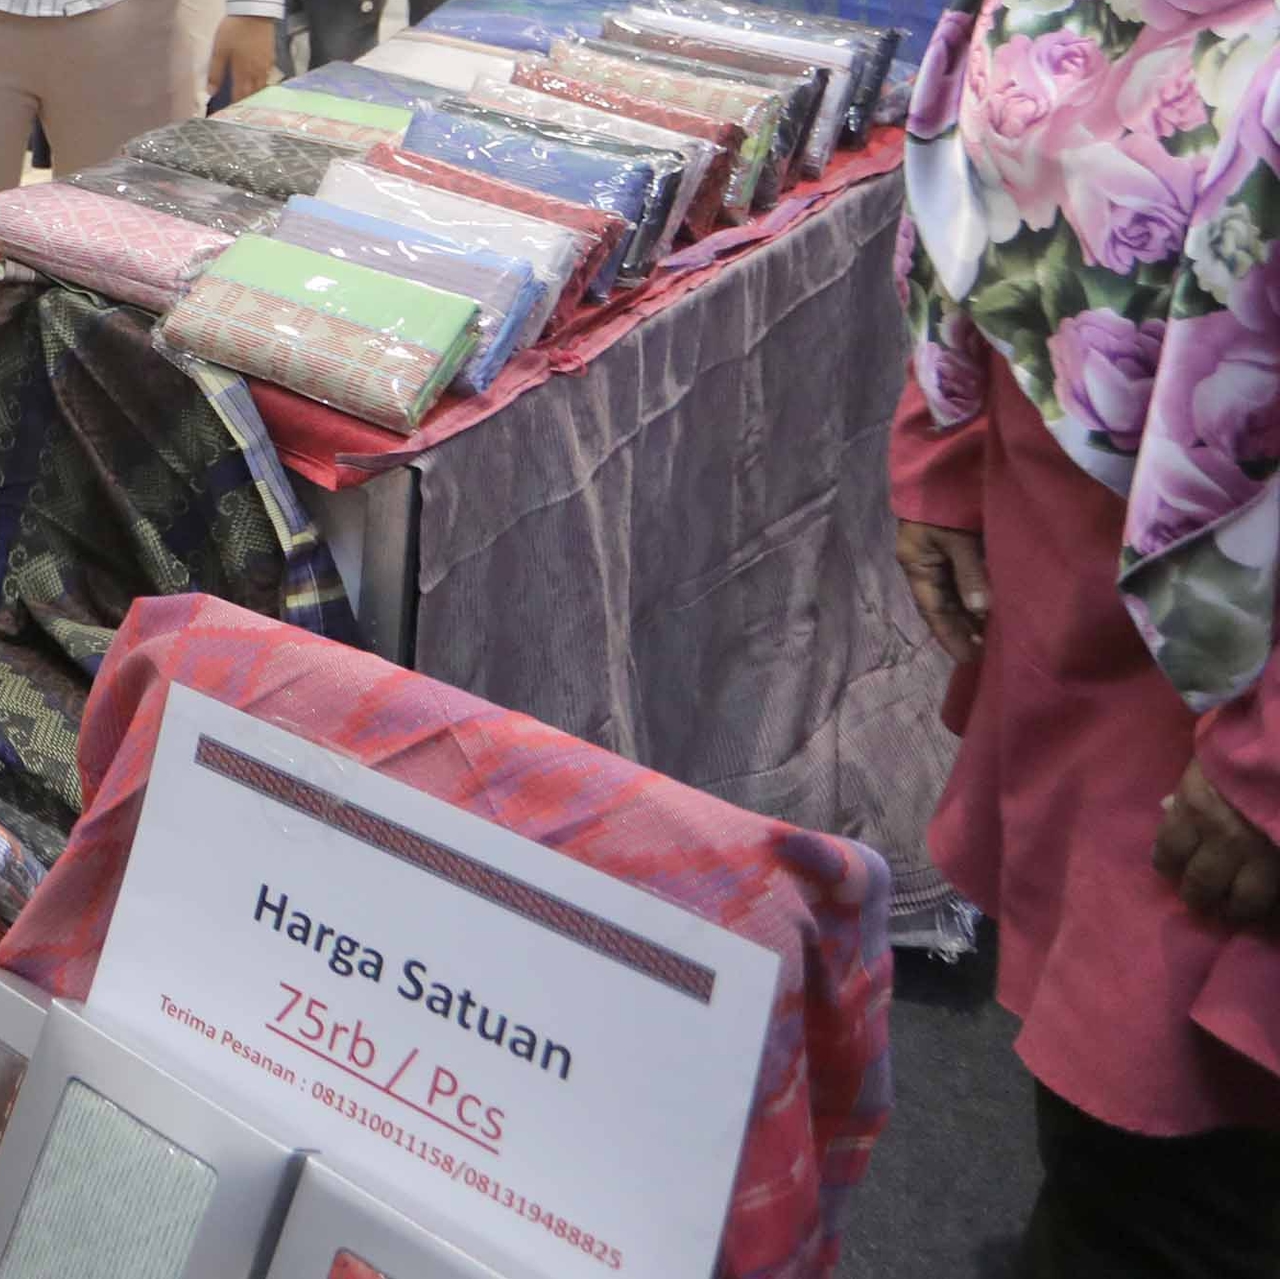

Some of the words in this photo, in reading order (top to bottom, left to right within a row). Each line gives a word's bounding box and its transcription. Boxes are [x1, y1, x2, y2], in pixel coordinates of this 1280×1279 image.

[158, 994, 216, 1042] Terima
[221, 1029, 297, 1091] Pesanan
[253, 883, 385, 982] Harga
[397, 957, 574, 1081] Satuan
[272, 980, 378, 1070] 75rb
[385, 1047, 420, 1095] /
[428, 1069, 506, 1142] Pcs
